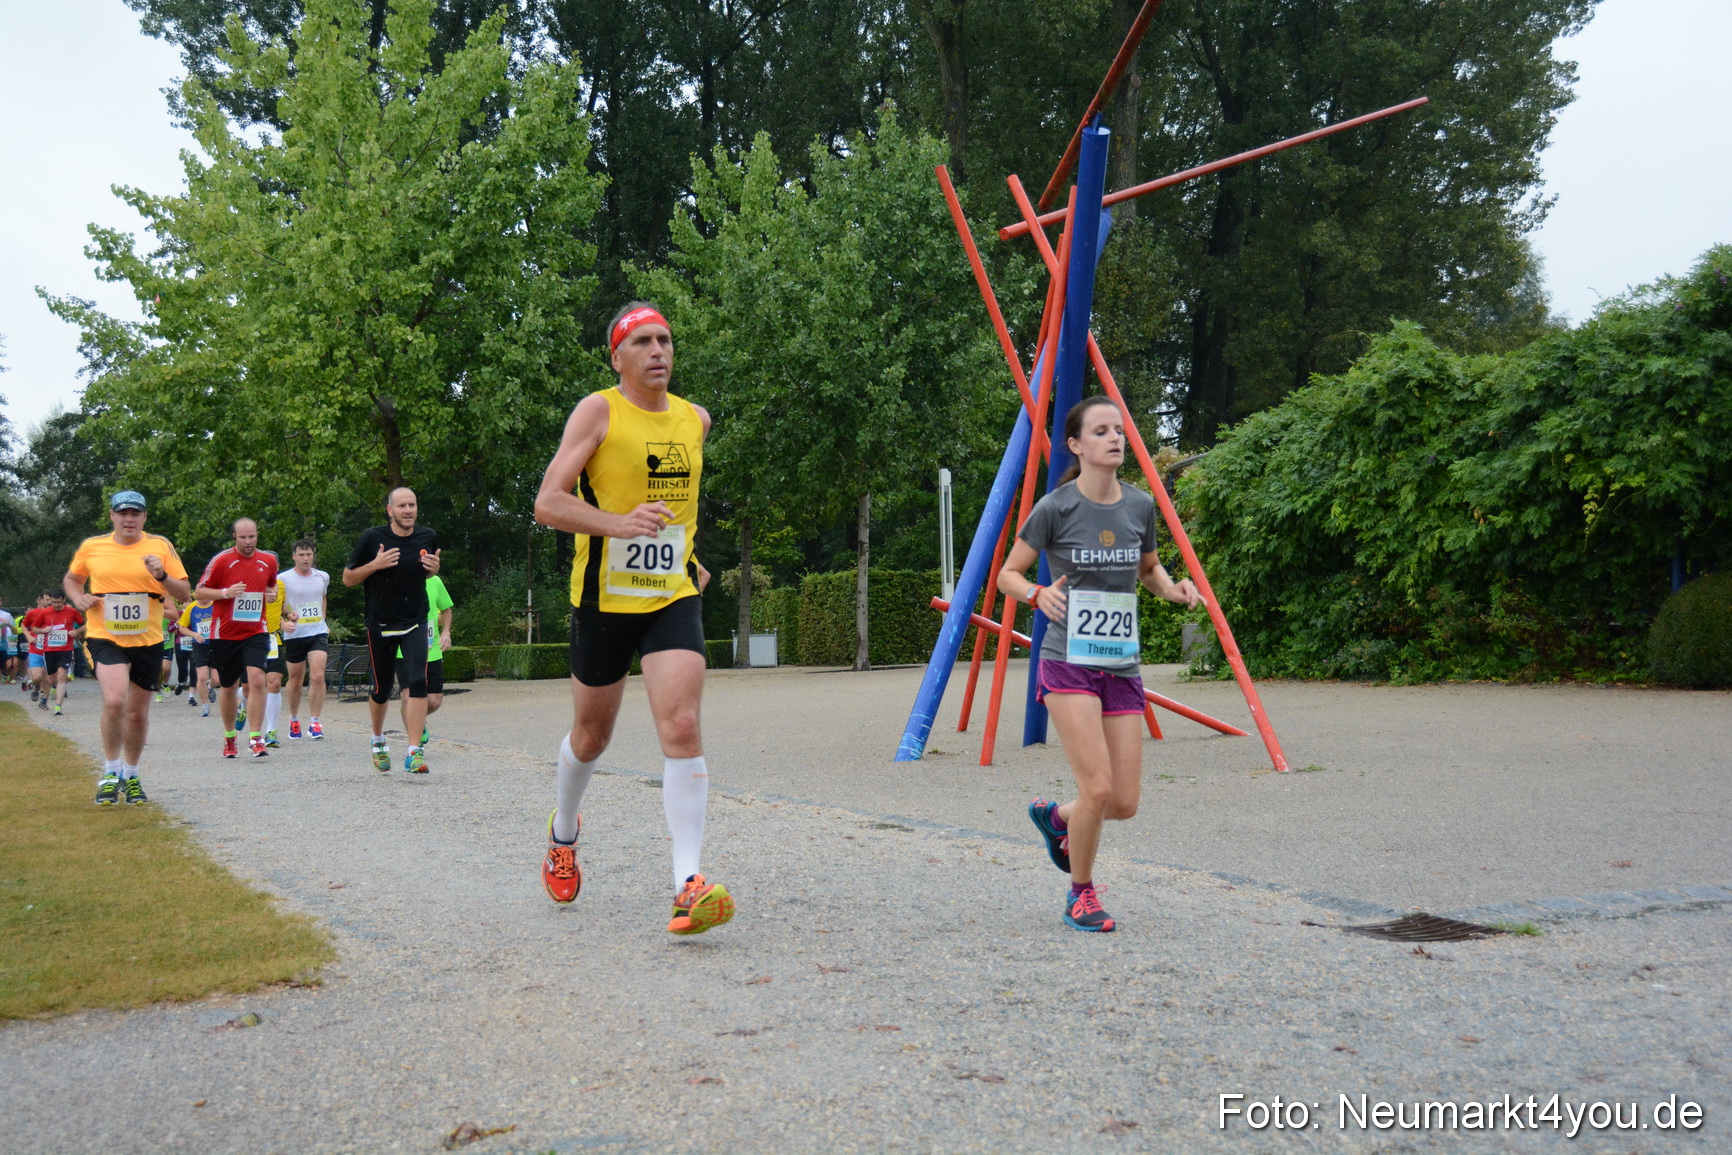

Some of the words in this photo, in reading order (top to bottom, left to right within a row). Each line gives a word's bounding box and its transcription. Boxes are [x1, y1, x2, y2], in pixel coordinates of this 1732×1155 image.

[647, 479, 690, 489] HIRSCH
[626, 543, 674, 571] 209
[1071, 548, 1141, 563] LEHMEIER
[631, 575, 667, 588] Robert
[237, 599, 262, 611] 2007
[113, 604, 141, 620] 103
[302, 607, 318, 617] 213
[1077, 609, 1132, 638] 2229
[50, 633, 66, 641] 2263
[1087, 643, 1123, 656] Theresa
